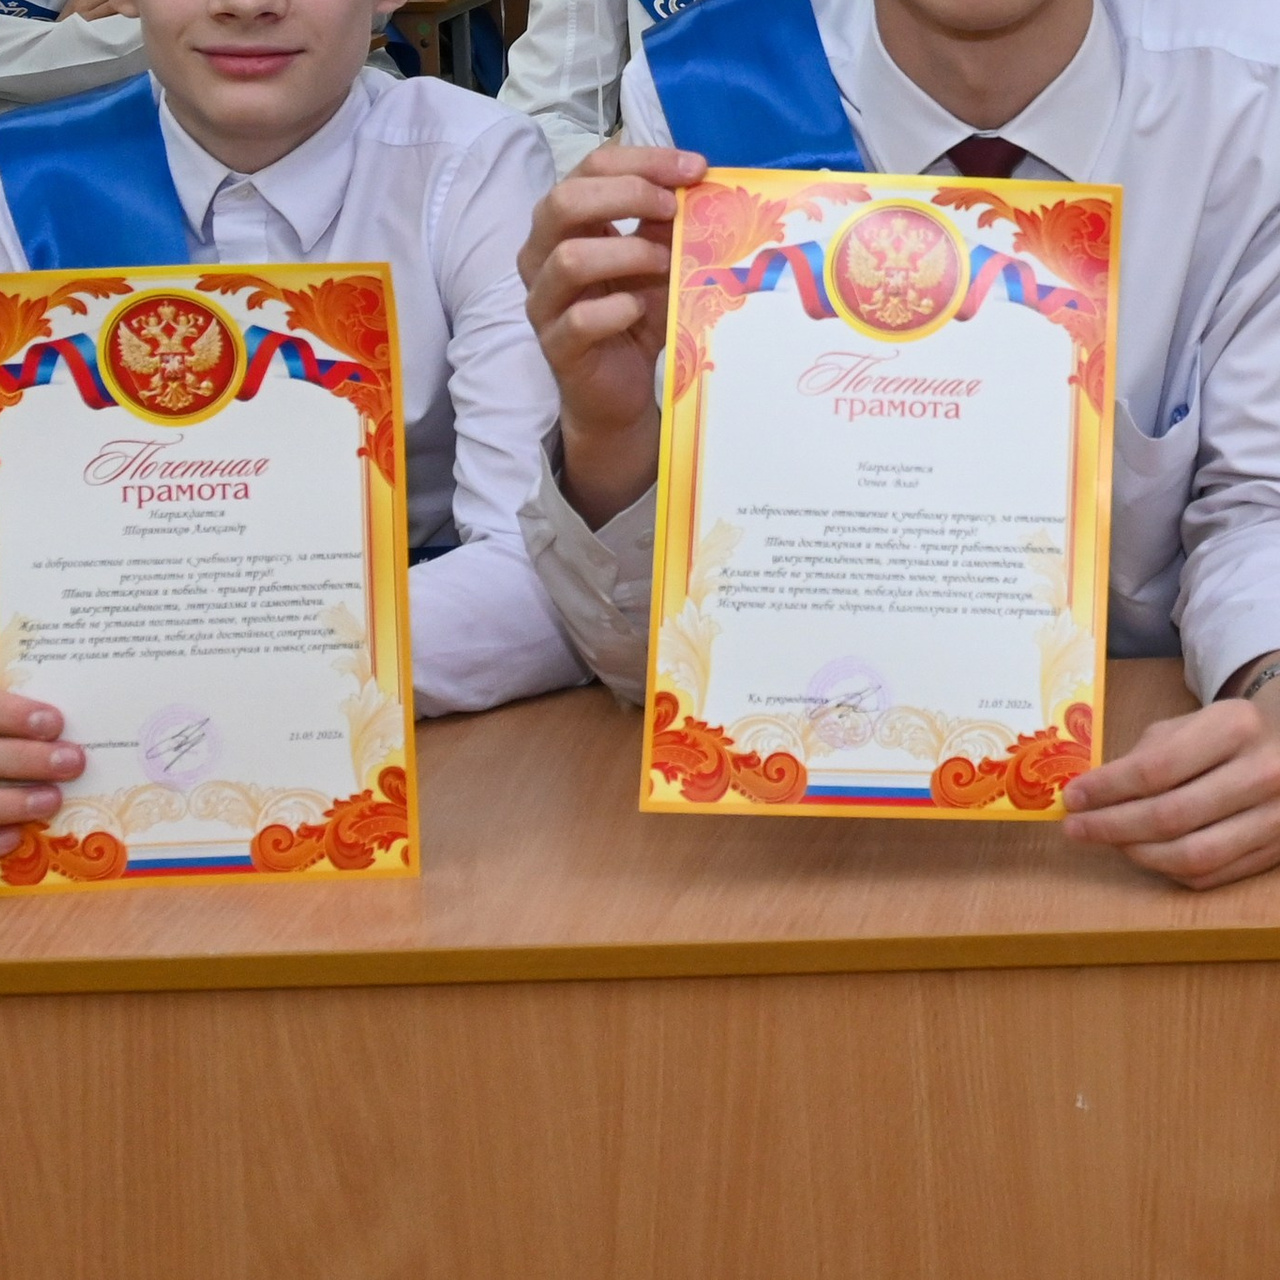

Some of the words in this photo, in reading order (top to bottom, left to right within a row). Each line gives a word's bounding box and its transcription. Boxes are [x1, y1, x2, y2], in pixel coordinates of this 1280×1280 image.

[796, 349, 983, 397] Почетная
[833, 396, 961, 422] грамота
[83, 433, 270, 486] Почетная
[121, 481, 250, 509] грамота
